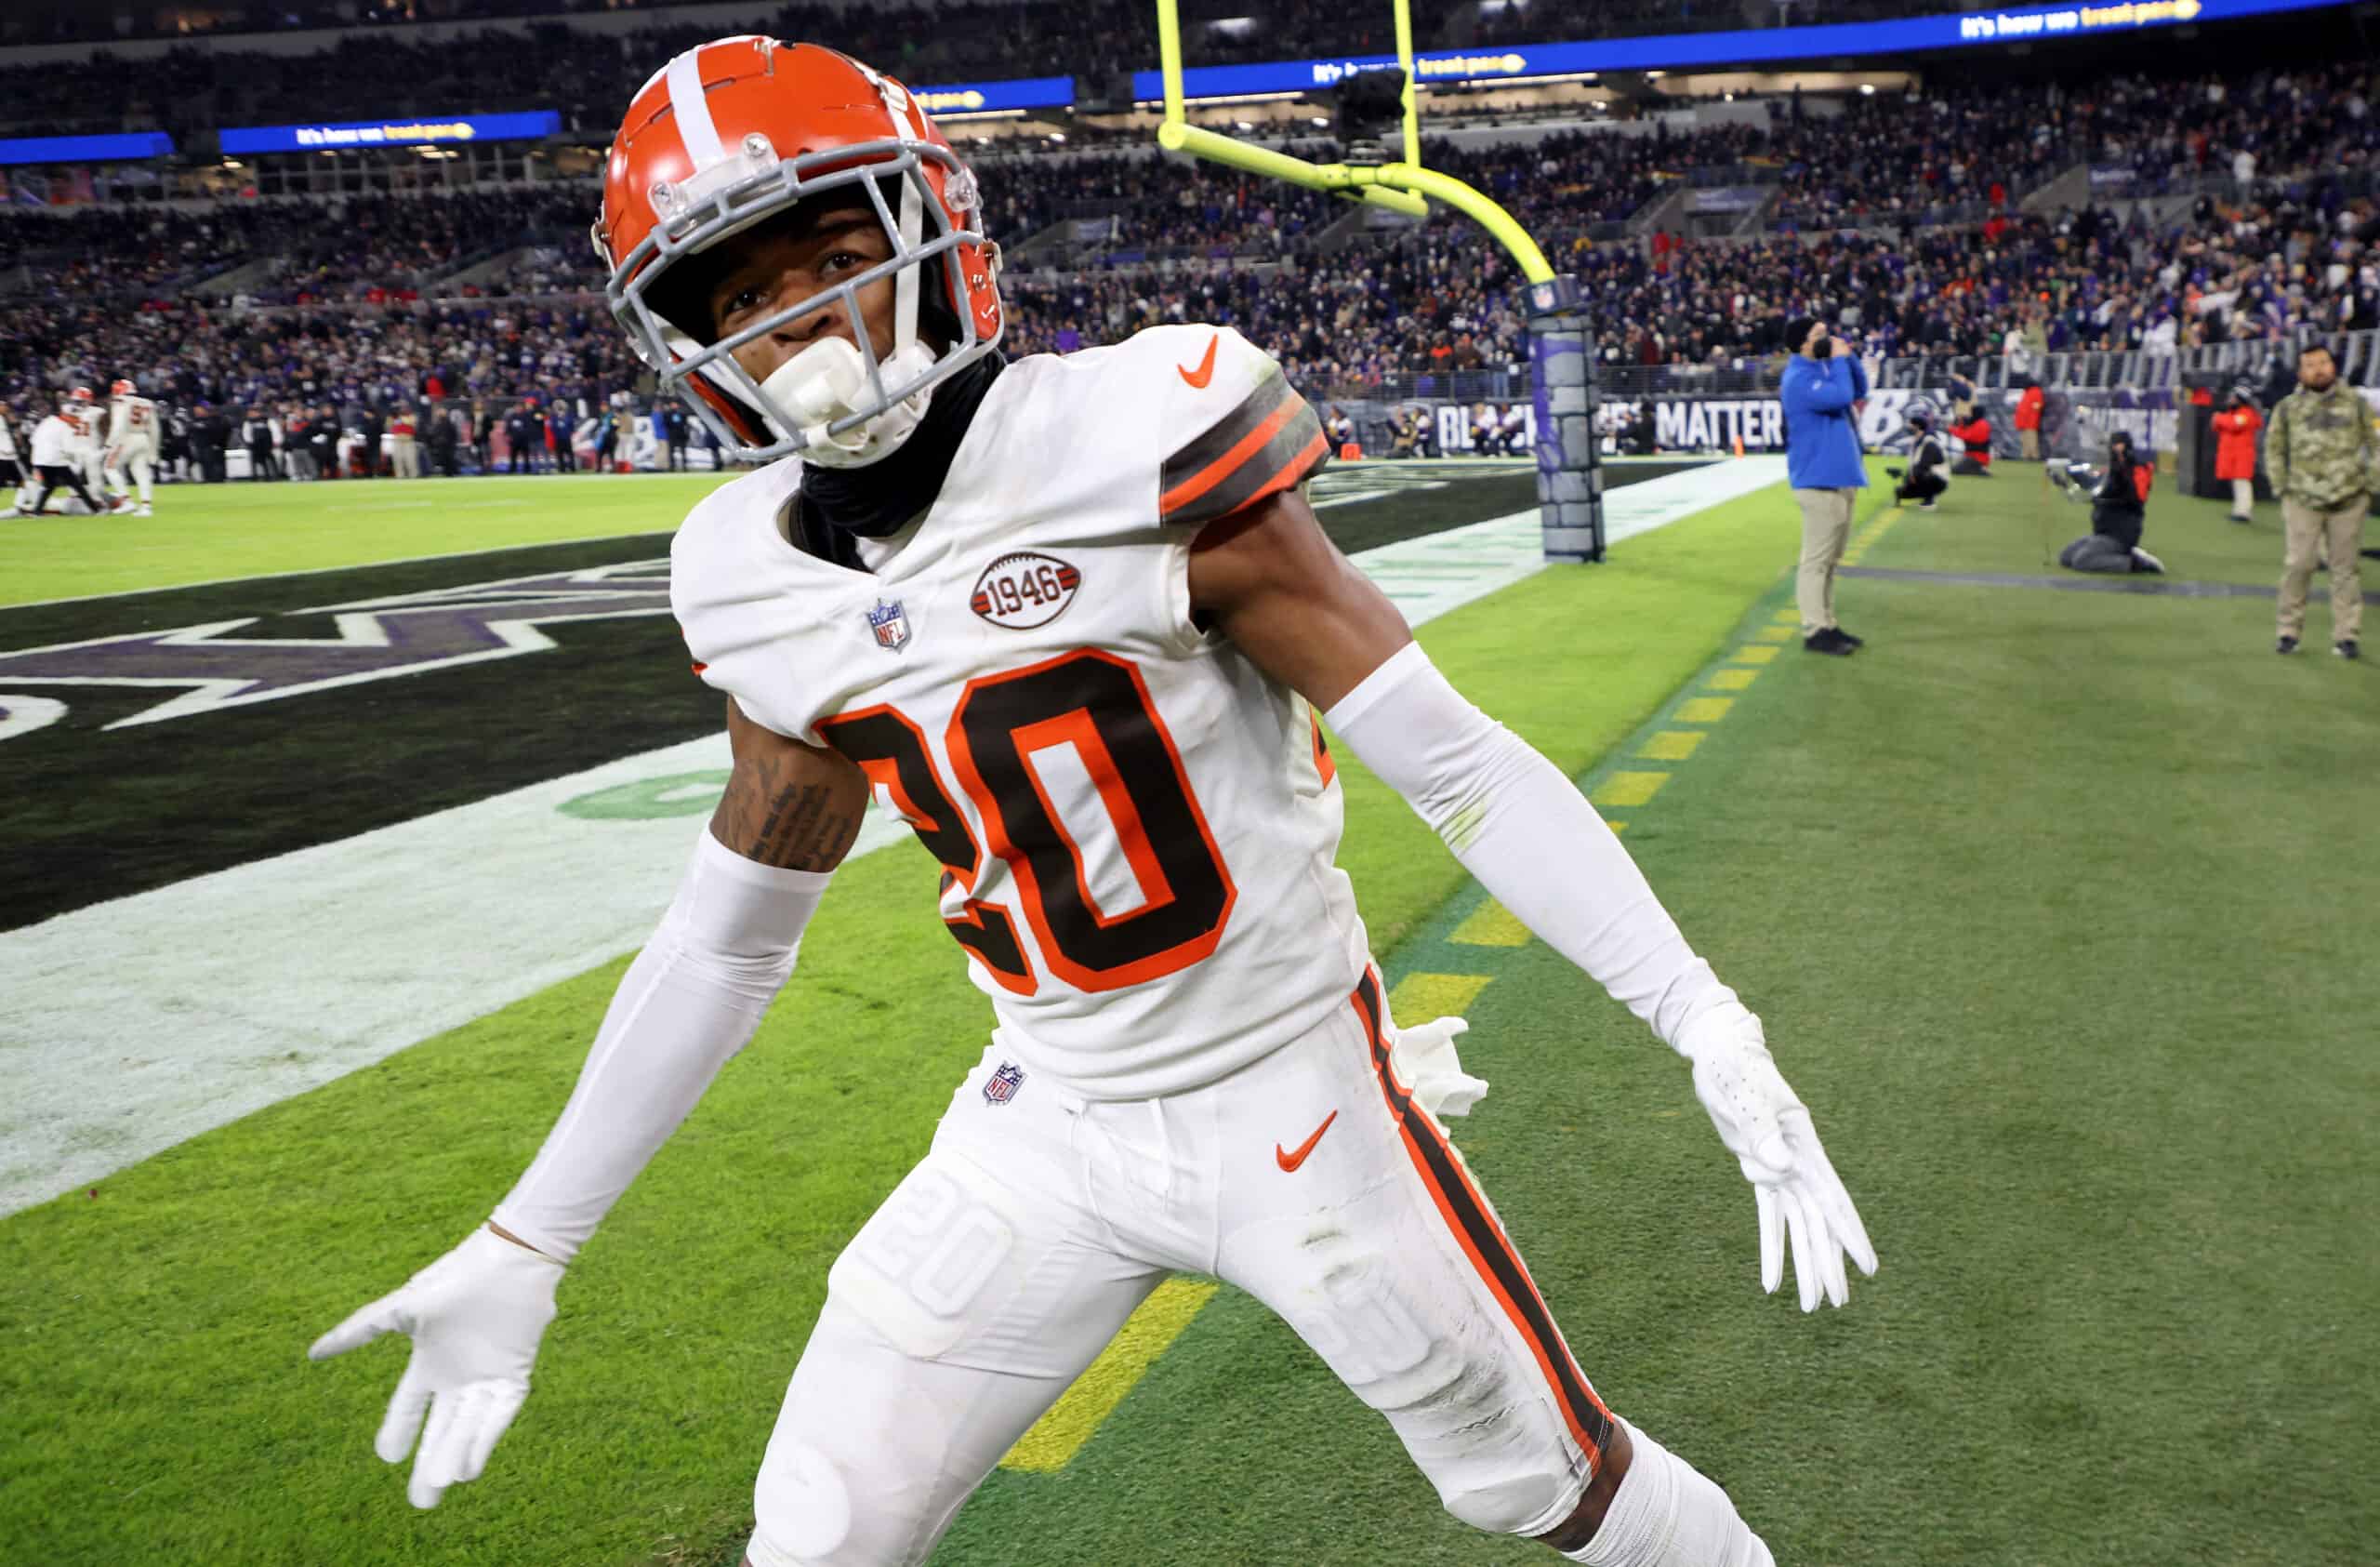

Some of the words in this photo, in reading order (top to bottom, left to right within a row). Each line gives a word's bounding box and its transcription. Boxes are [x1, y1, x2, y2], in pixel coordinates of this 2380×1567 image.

[987, 564, 1061, 618] 1946
[876, 620, 906, 644] NFL
[811, 646, 1238, 997] 20
[987, 1077, 1011, 1098] NFL
[855, 1168, 1015, 1319] 20
